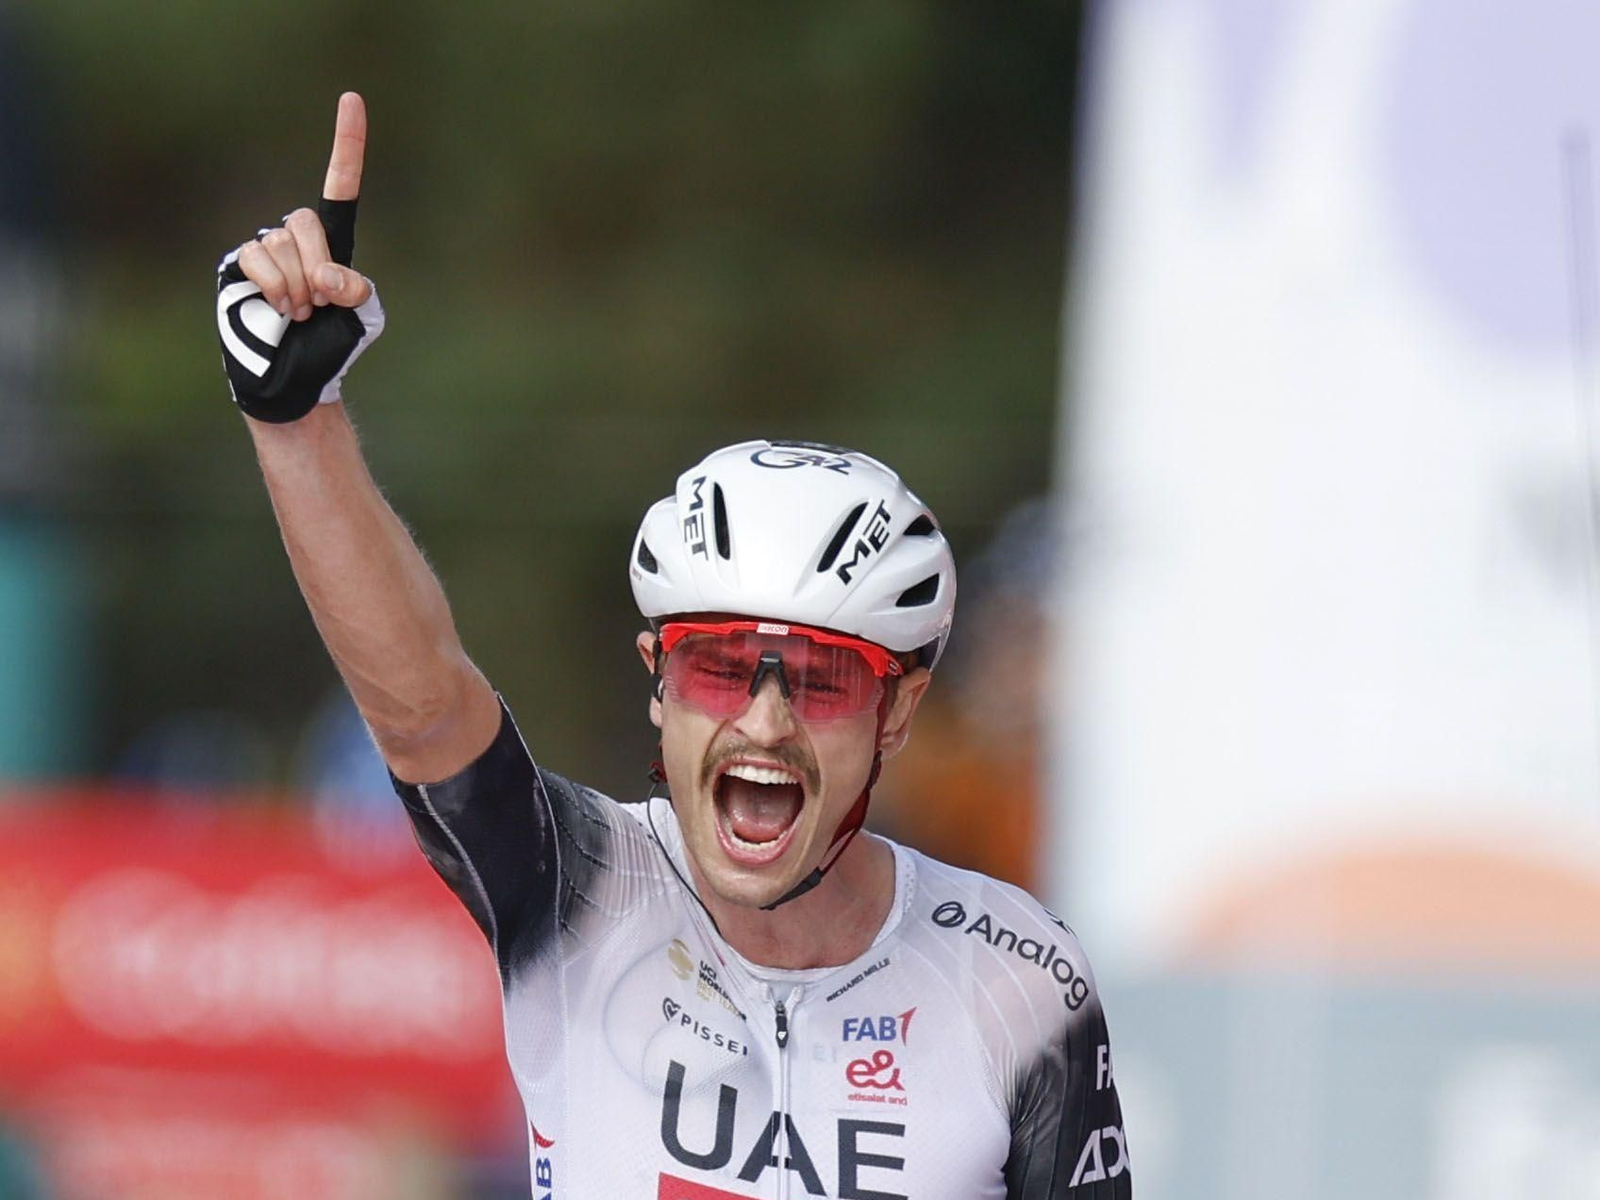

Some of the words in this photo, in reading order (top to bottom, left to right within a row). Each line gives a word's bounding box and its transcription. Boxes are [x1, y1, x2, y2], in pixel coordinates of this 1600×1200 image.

[683, 476, 709, 561] MET
[836, 499, 891, 585] MET
[964, 913, 1089, 1011] Analog
[842, 1016, 897, 1041] FAB
